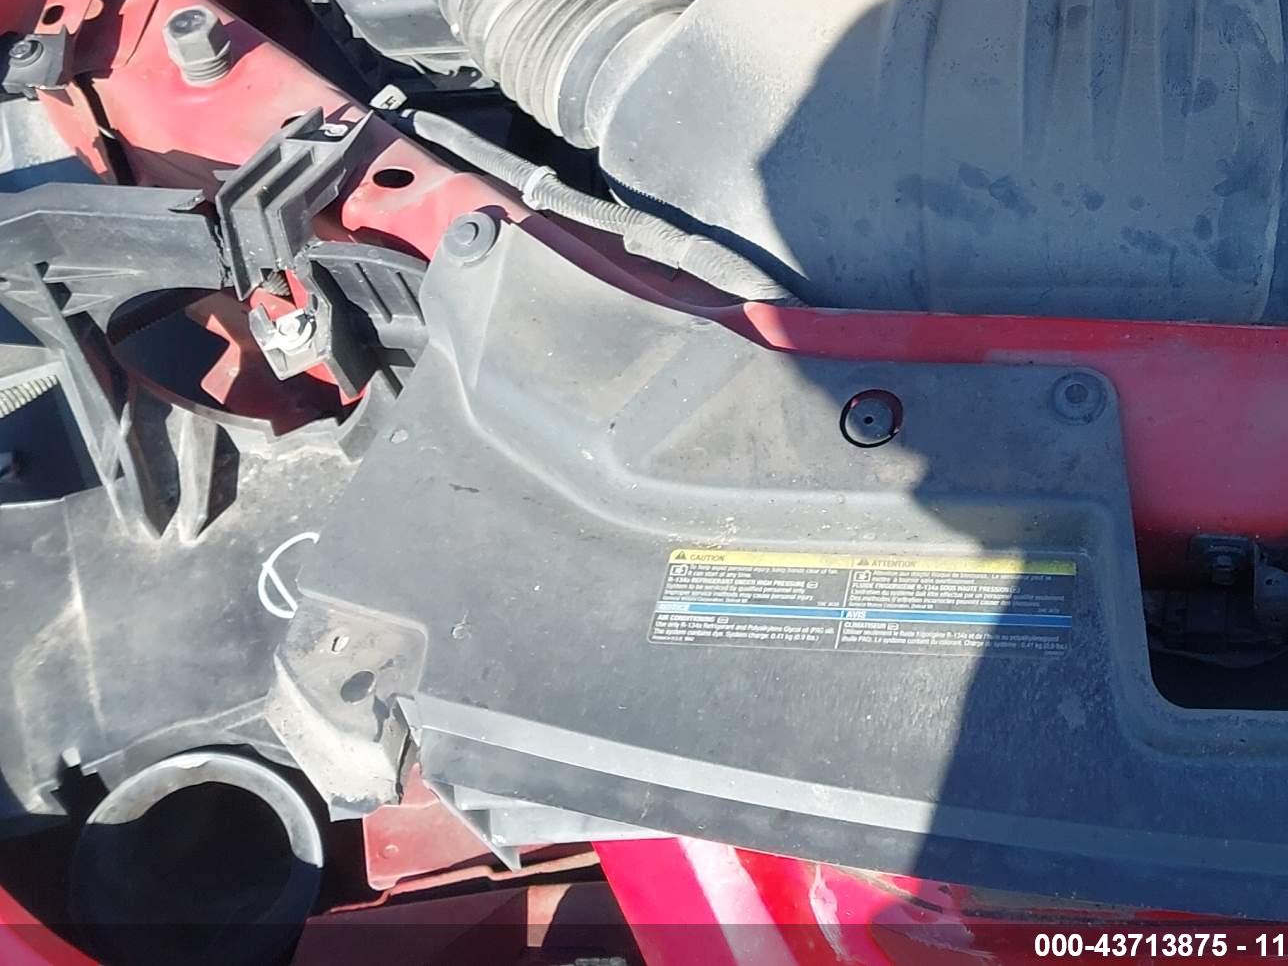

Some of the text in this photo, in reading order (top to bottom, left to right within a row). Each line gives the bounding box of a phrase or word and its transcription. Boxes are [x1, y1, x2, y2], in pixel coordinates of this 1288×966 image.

[690, 554, 725, 562] CAUTION
[871, 560, 917, 568] ATTENTION
[846, 610, 866, 619] AVIS
